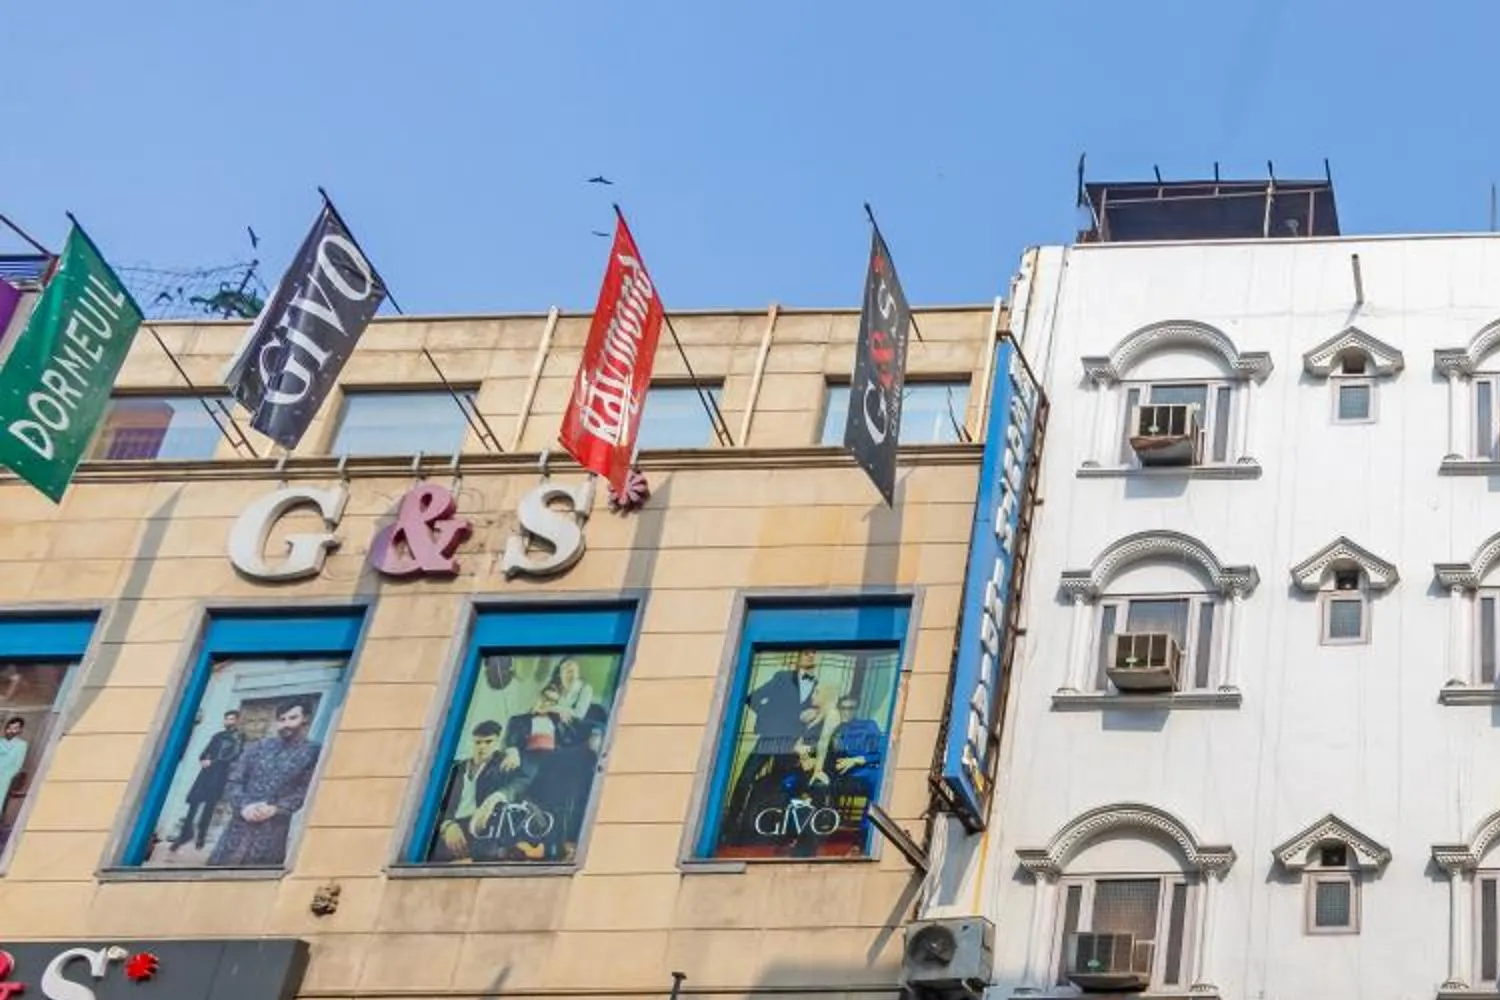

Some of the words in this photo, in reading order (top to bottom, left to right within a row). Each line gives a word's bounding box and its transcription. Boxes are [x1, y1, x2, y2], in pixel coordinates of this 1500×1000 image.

[8, 275, 126, 461] DORMEUIL
[257, 233, 373, 406] GIVO
[577, 253, 656, 448] Raymond
[755, 802, 840, 835] GIVO
